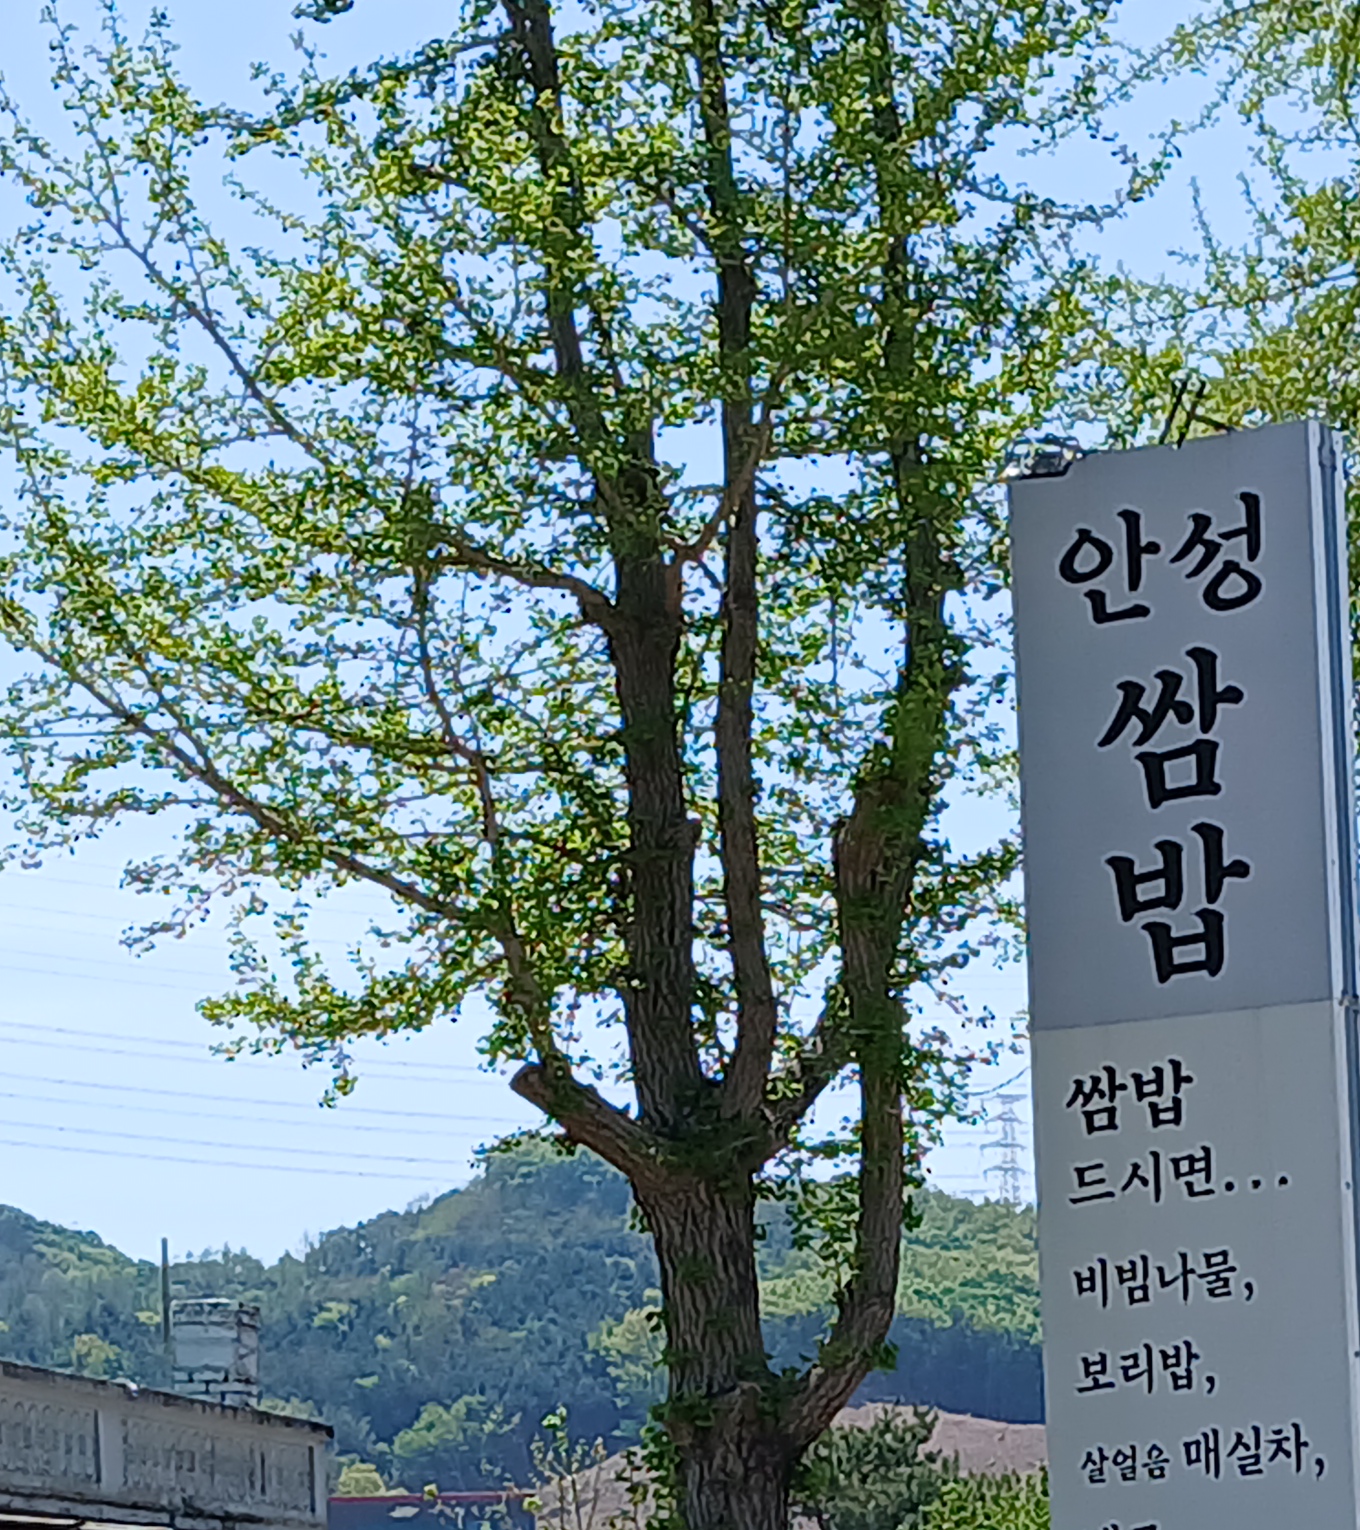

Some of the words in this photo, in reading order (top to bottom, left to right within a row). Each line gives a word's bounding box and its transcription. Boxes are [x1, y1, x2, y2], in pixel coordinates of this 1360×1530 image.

[1057, 490, 1264, 626] 안성
[1064, 1057, 1195, 1137] 쌈밥
[1072, 1248, 1255, 1310] 비빔나물,
[1075, 1339, 1216, 1396] 보리밥,
[1080, 1442, 1171, 1485] 살얼음
[1181, 1421, 1326, 1480] 매실차,
